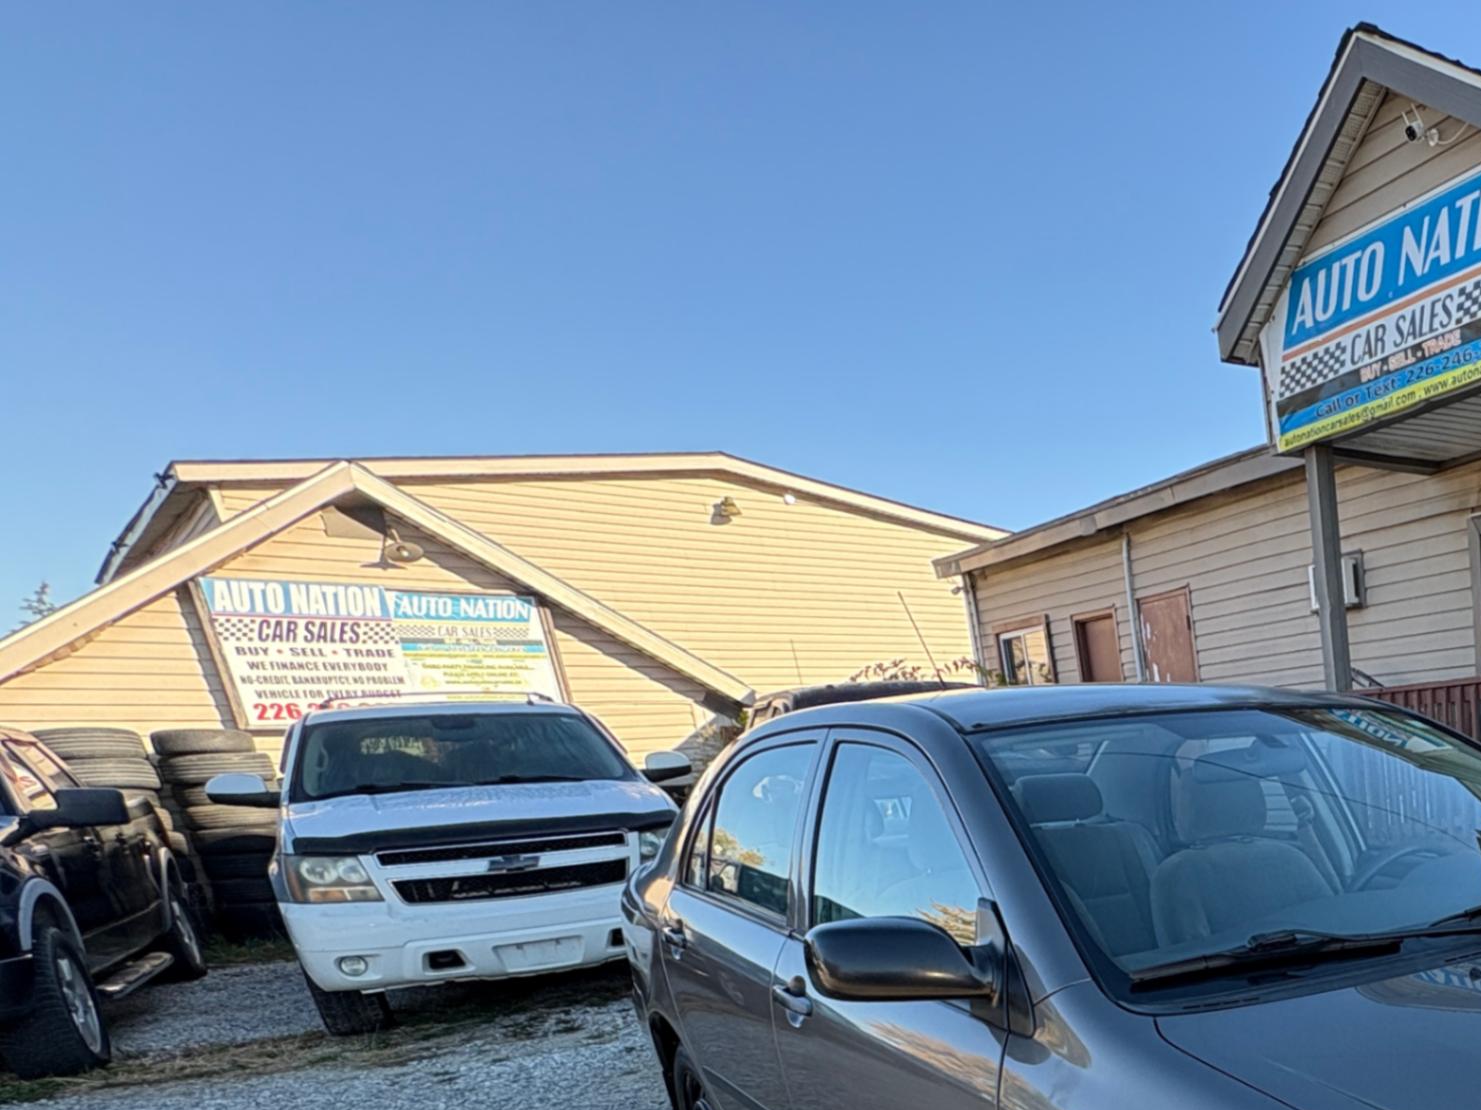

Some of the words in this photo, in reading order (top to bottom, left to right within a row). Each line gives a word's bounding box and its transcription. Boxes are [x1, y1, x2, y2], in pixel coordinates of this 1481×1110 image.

[1292, 242, 1385, 335] AUTO
[1350, 323, 1387, 366] CAR
[1393, 295, 1455, 348] SALES
[1360, 362, 1382, 383] BUY
[1422, 329, 1461, 357] TRADE
[1316, 400, 1340, 417] Call
[1345, 393, 1360, 405] or
[214, 581, 285, 614] AUTO
[290, 584, 382, 617] NATION
[400, 595, 451, 618] AUTO
[459, 596, 528, 620] NATION
[258, 619, 298, 643] CAR
[304, 620, 361, 644] SALES
[438, 626, 459, 637] CAR
[463, 627, 492, 638] SALES
[235, 646, 269, 656] BUY
[289, 647, 327, 657] SELL
[343, 648, 395, 658] TRADE
[247, 661, 268, 671] WE
[270, 661, 320, 671] FINANCE
[323, 662, 388, 672] EVERYBODY
[366, 676, 405, 686] PROBLEM
[254, 690, 300, 699] VEHICLE
[302, 690, 324, 699] FOR
